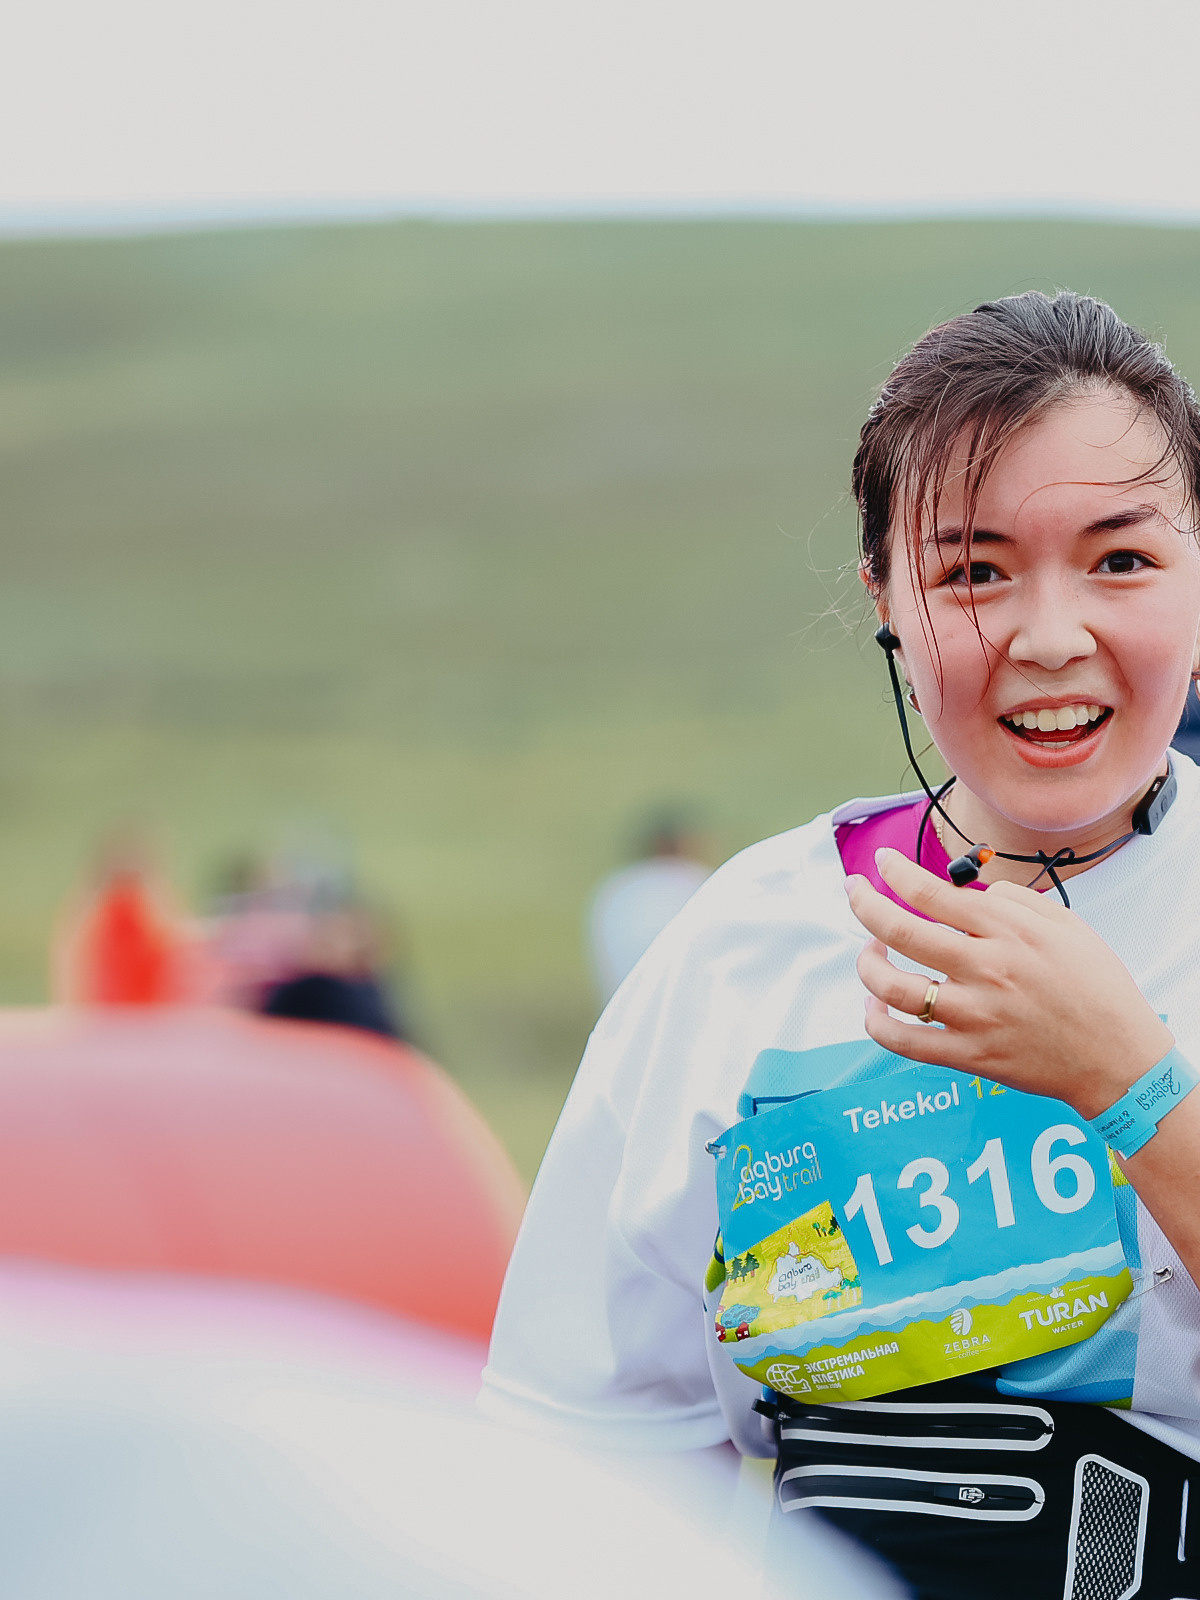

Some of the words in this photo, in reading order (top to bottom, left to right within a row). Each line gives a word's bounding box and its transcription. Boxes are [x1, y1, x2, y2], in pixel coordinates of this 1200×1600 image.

[843, 1081, 960, 1133] Tekekol
[740, 1142, 817, 1183] aqbura
[844, 1123, 1096, 1266] 1316
[1018, 1291, 1109, 1330] TURAN
[1051, 1319, 1084, 1334] WATER
[803, 1341, 900, 1374] ЭКСТРЕМАЛЬНАЯ
[943, 1334, 991, 1355] ZEBRA
[958, 1349, 980, 1360] coffee
[811, 1365, 865, 1384] АТЛЕТИКА
